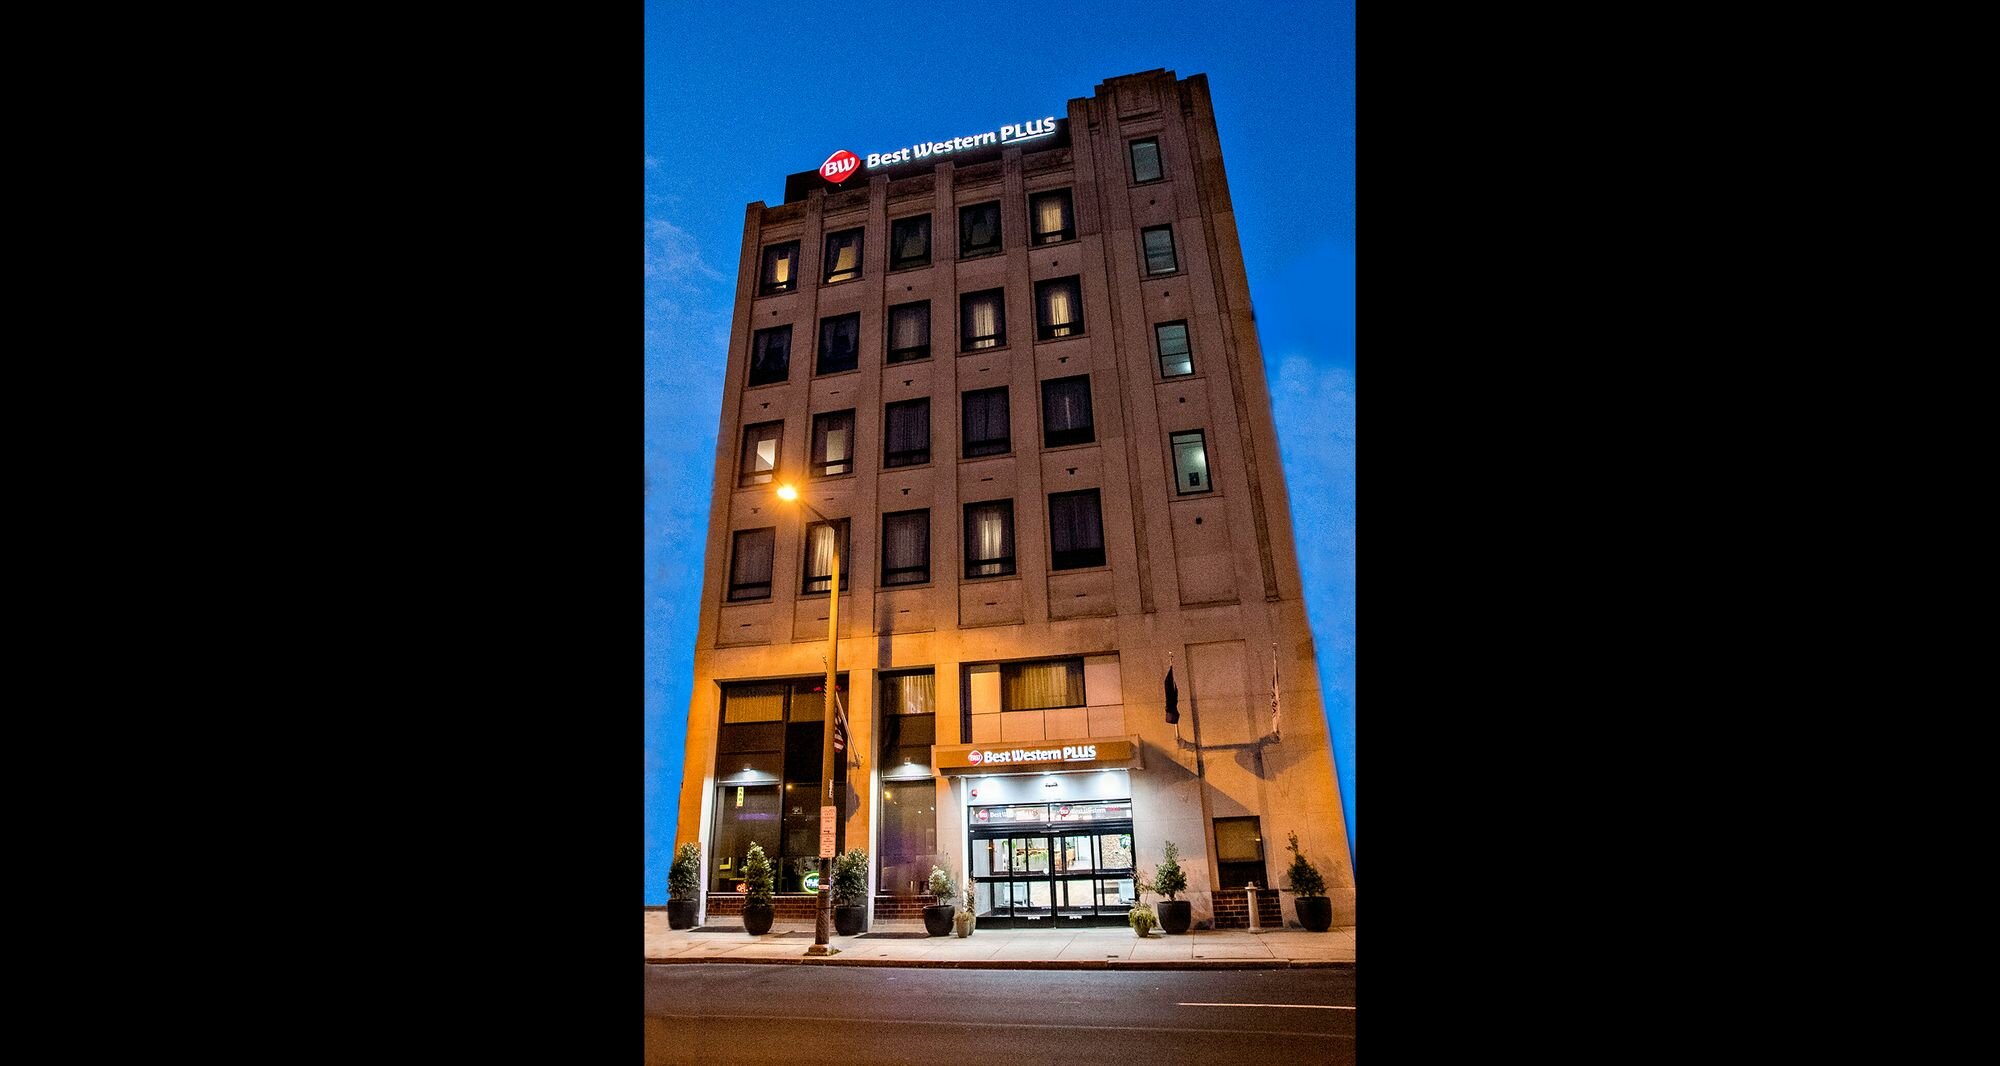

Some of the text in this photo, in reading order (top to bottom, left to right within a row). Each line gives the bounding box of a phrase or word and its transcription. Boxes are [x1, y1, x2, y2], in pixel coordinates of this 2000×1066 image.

[825, 116, 1056, 177] BW Best Western PLUS
[984, 750, 1011, 763] Best
[1012, 749, 1062, 762] Western
[1063, 745, 1097, 760] PLUS
